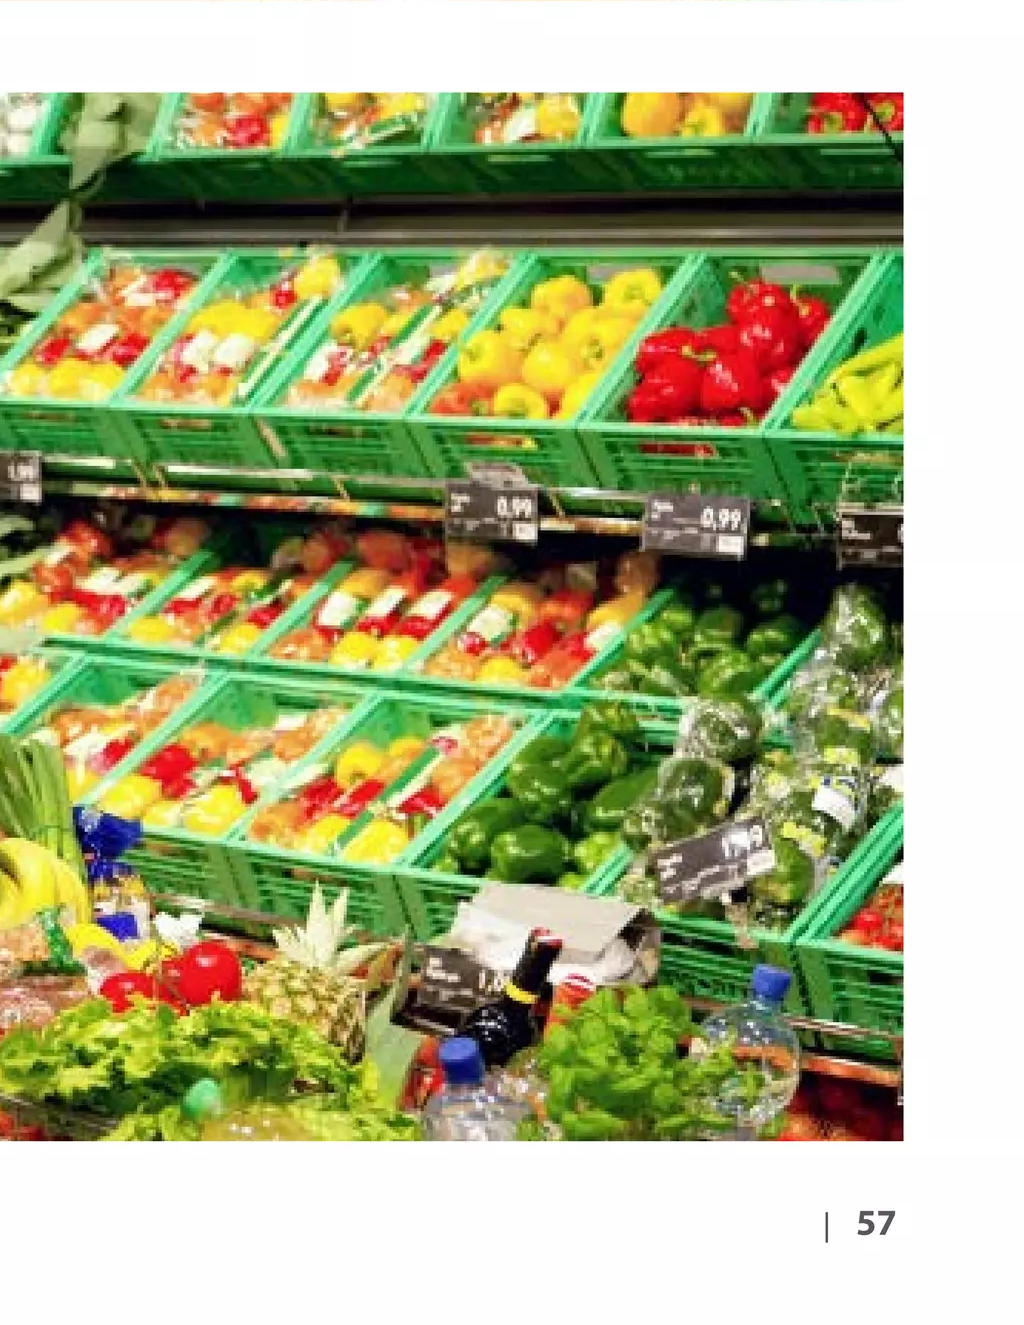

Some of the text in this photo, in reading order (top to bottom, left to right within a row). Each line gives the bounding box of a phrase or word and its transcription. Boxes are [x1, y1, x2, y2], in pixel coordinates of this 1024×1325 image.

[497, 495, 532, 519] 0,99
[702, 507, 741, 532] 0,99
[858, 1211, 895, 1235] 57
